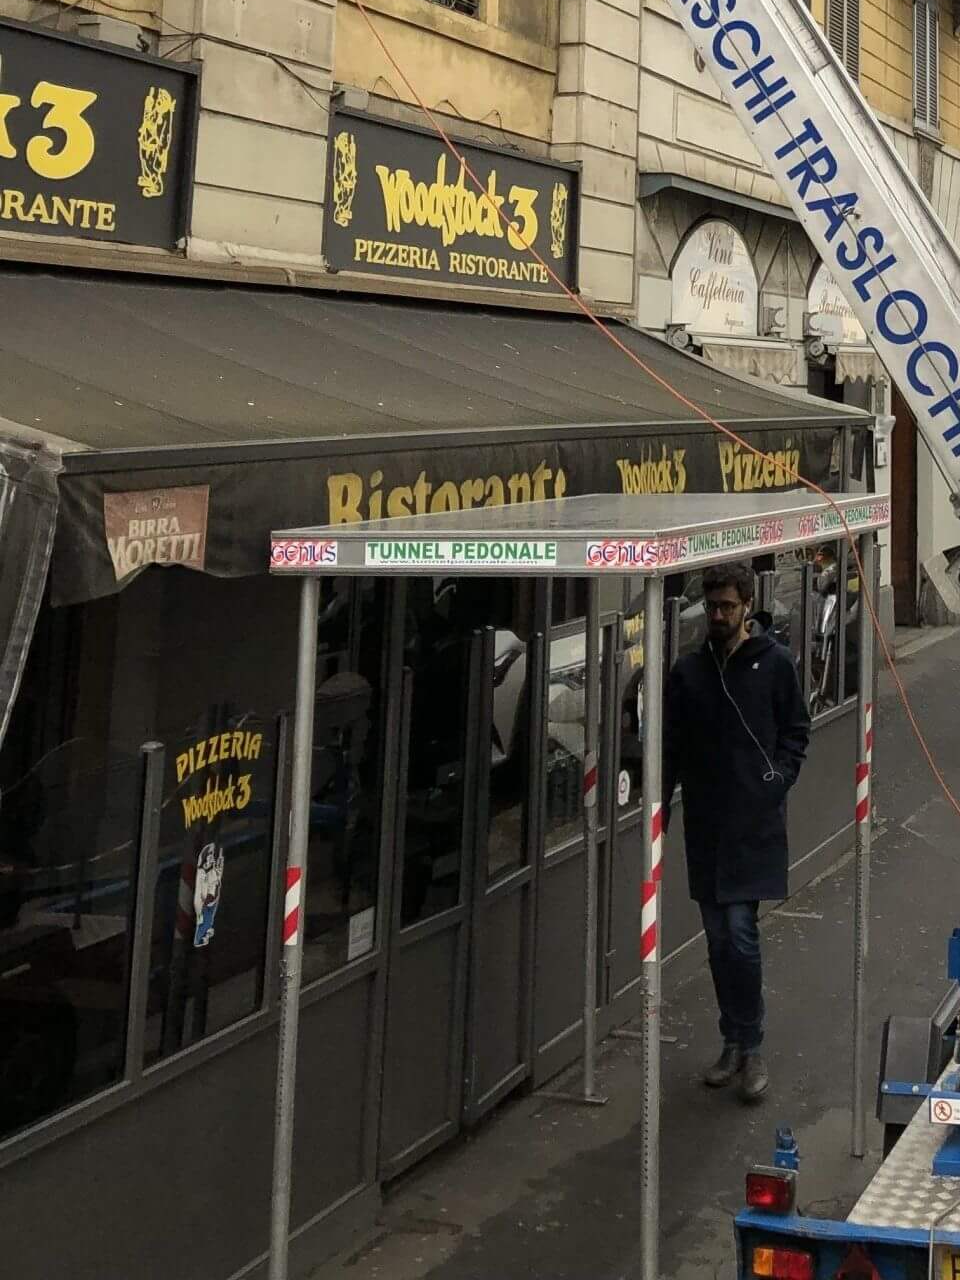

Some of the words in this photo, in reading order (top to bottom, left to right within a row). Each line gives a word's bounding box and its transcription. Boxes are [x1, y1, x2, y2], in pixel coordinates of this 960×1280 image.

[26, 81, 98, 180] 3
[0, 189, 116, 232] RANTE
[375, 152, 505, 247] Woodstock
[507, 185, 539, 251] 3
[354, 238, 441, 271] PIZZERIA
[449, 252, 550, 283] RISTORANTE
[718, 438, 800, 493] Pizzeria
[128, 516, 180, 539] BIRRA
[688, 533, 720, 554] TUNNEL
[721, 525, 760, 548] PEDONALE
[820, 509, 842, 530] TUNNE
[107, 532, 203, 568] MORETTI
[367, 542, 444, 560] TUNNEL
[452, 542, 556, 561] PEDONALE
[176, 731, 262, 782] PIZZERIA
[182, 773, 236, 829] Woodstock
[236, 773, 252, 810] 3
